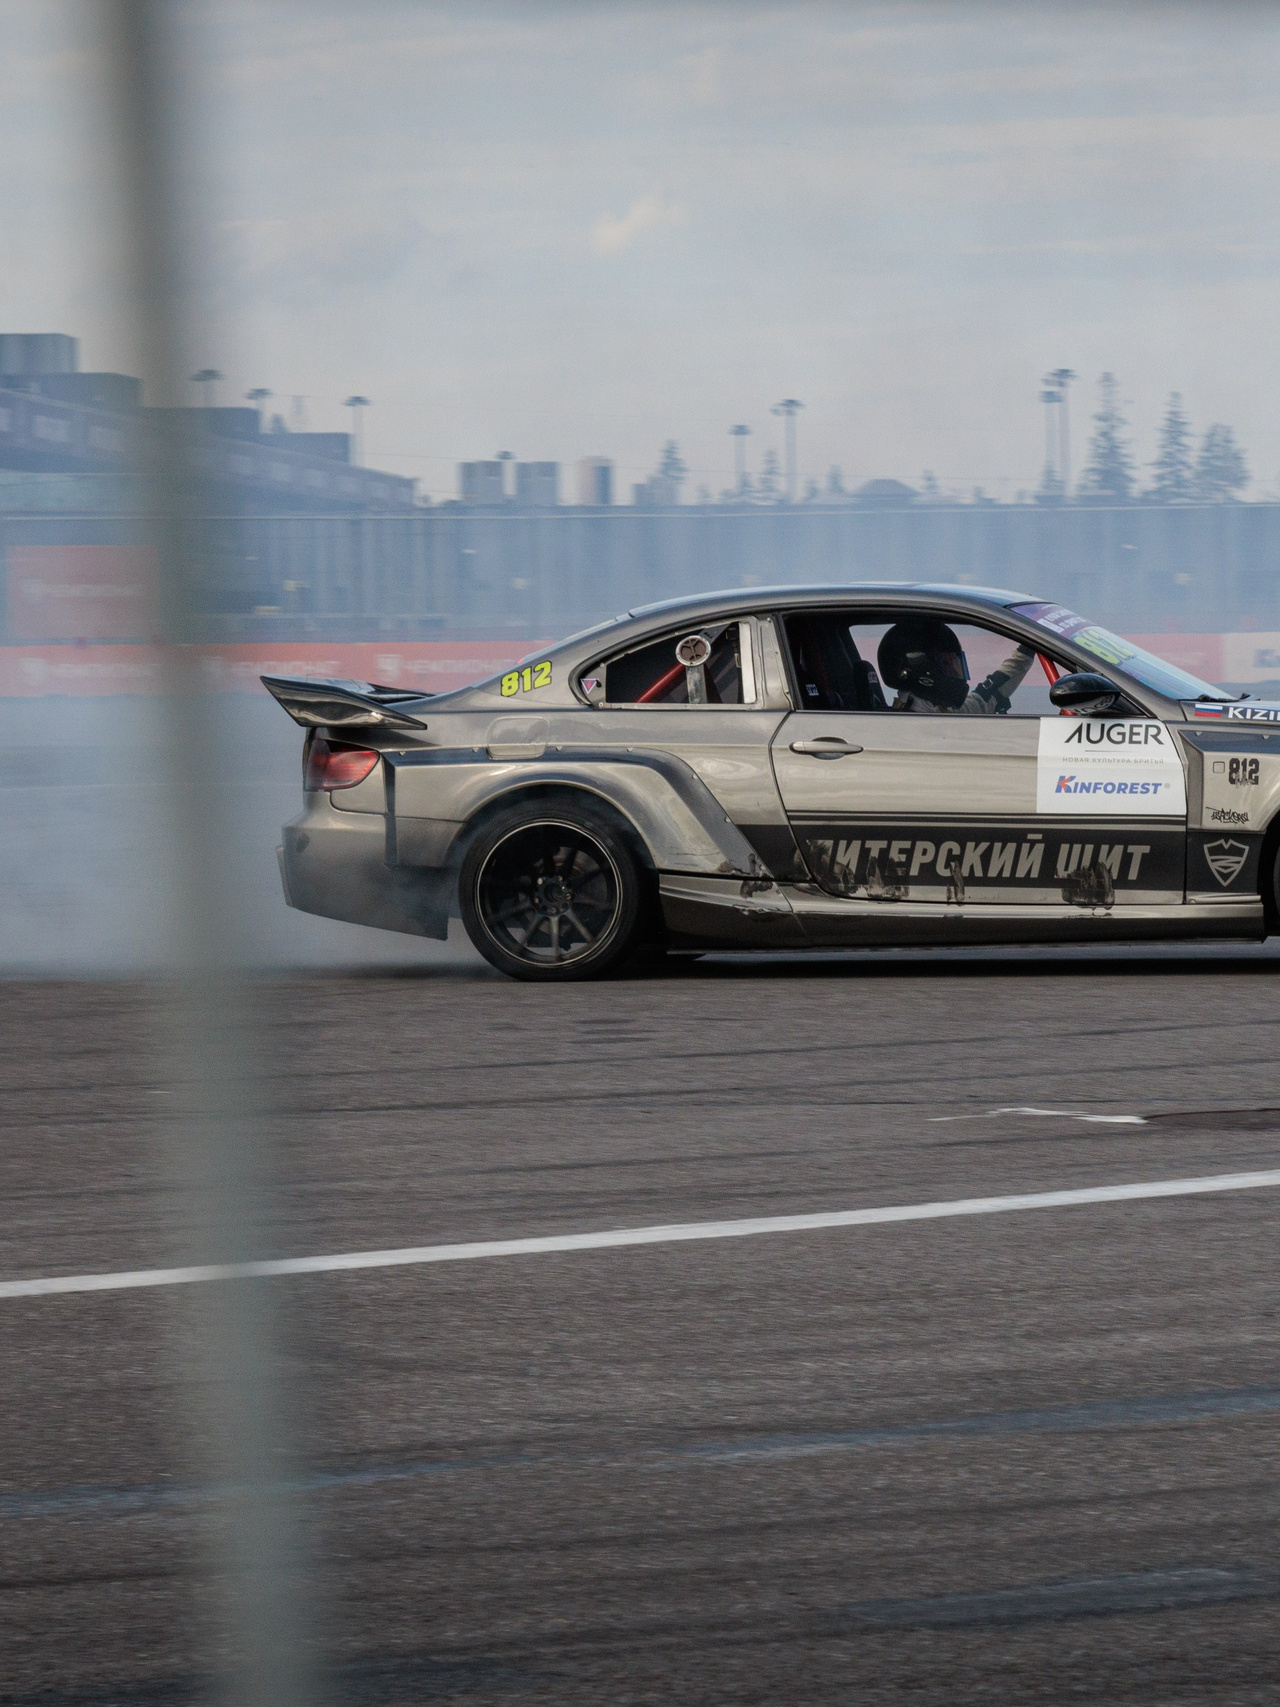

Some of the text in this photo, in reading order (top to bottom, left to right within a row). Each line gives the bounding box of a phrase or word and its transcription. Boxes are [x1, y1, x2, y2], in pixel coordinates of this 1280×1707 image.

[500, 660, 552, 697] 812
[1064, 722, 1165, 745] AUGER
[1229, 758, 1260, 785] 812
[1055, 775, 1162, 794] KINFOREST
